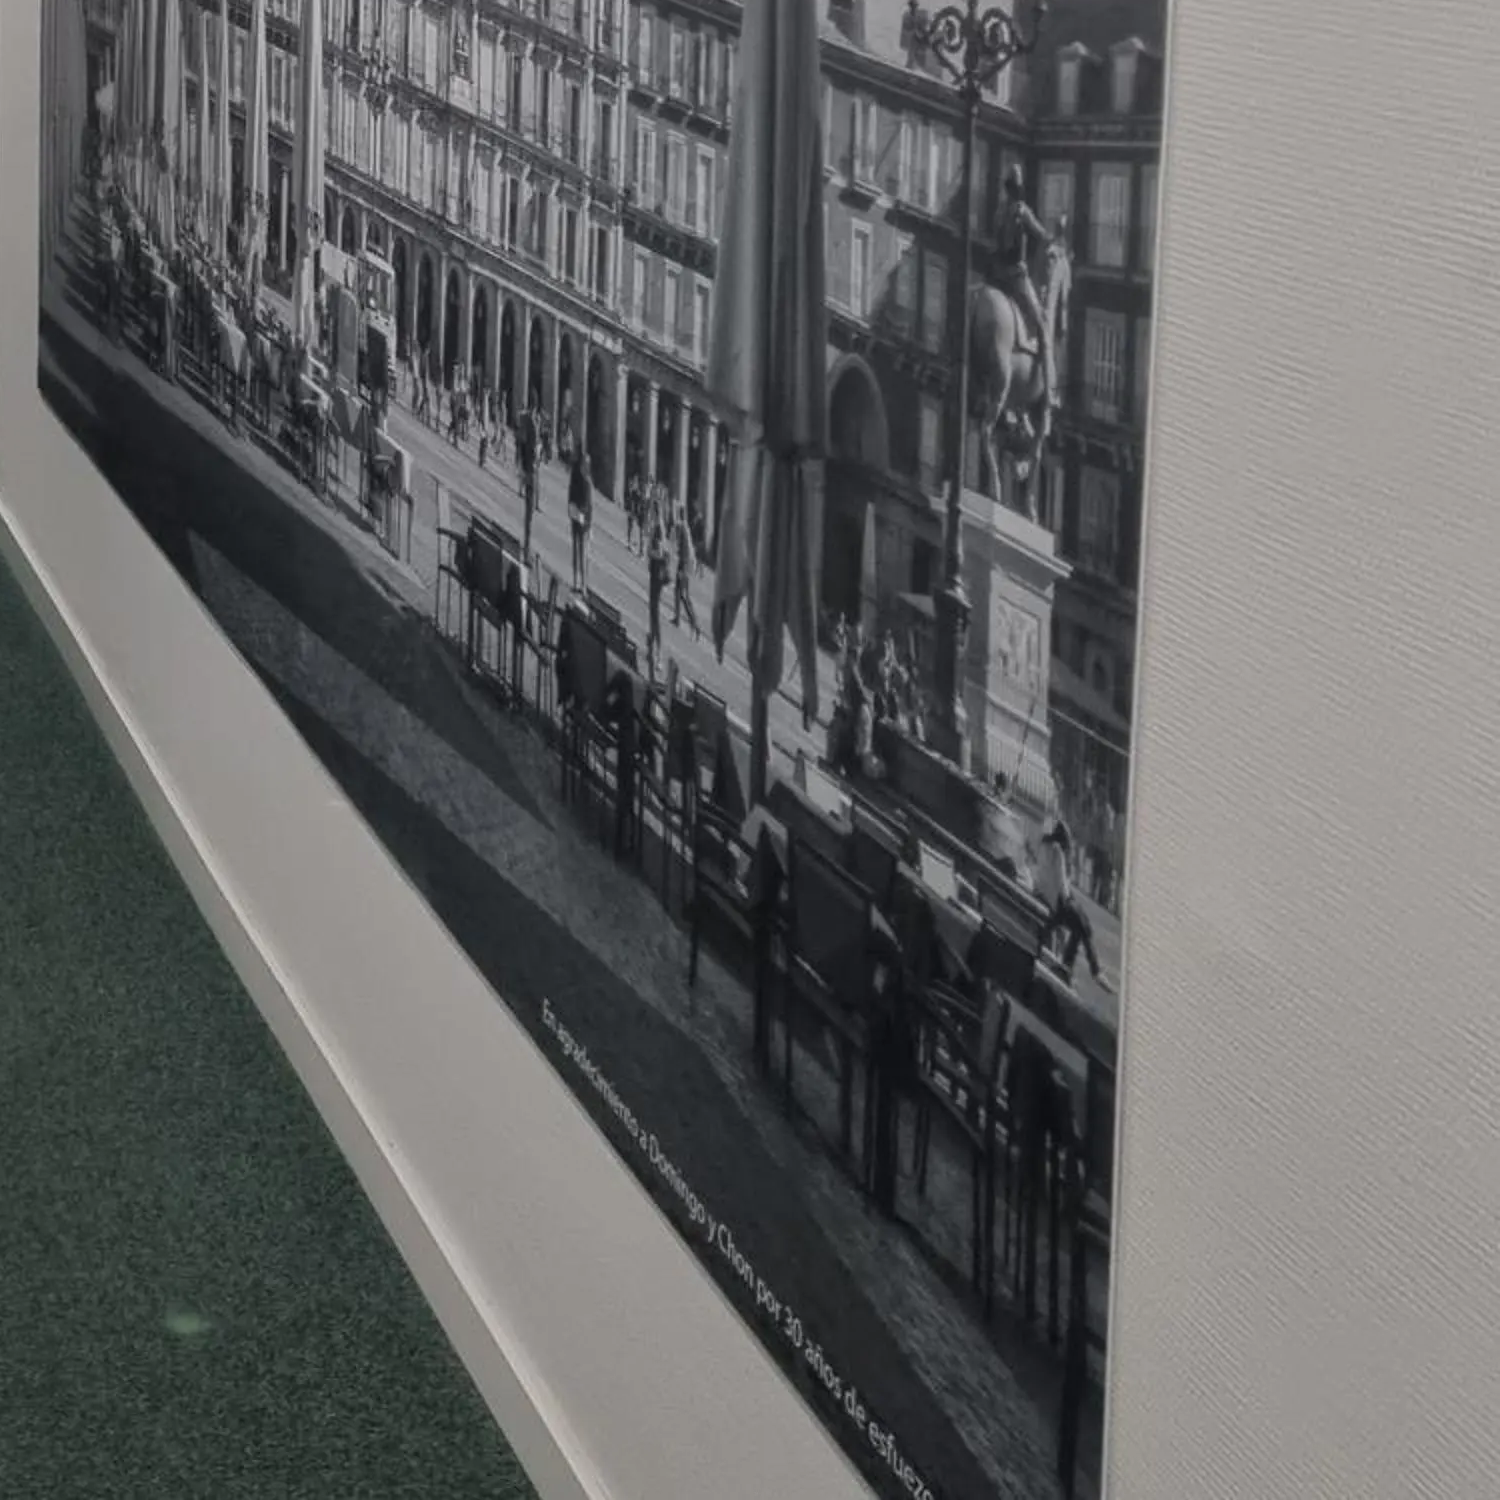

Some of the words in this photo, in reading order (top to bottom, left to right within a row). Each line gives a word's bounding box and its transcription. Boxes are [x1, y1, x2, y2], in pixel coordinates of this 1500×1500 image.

[542, 997, 557, 1031] En
[557, 1022, 639, 1137] agradecimiento
[639, 1128, 648, 1151] a
[649, 1133, 706, 1225] Domingo
[707, 1214, 717, 1243] y
[717, 1224, 754, 1289] Chon
[756, 1276, 782, 1322] por
[784, 1305, 803, 1348] 30
[805, 1337, 843, 1400] años
[844, 1386, 867, 1430] de
